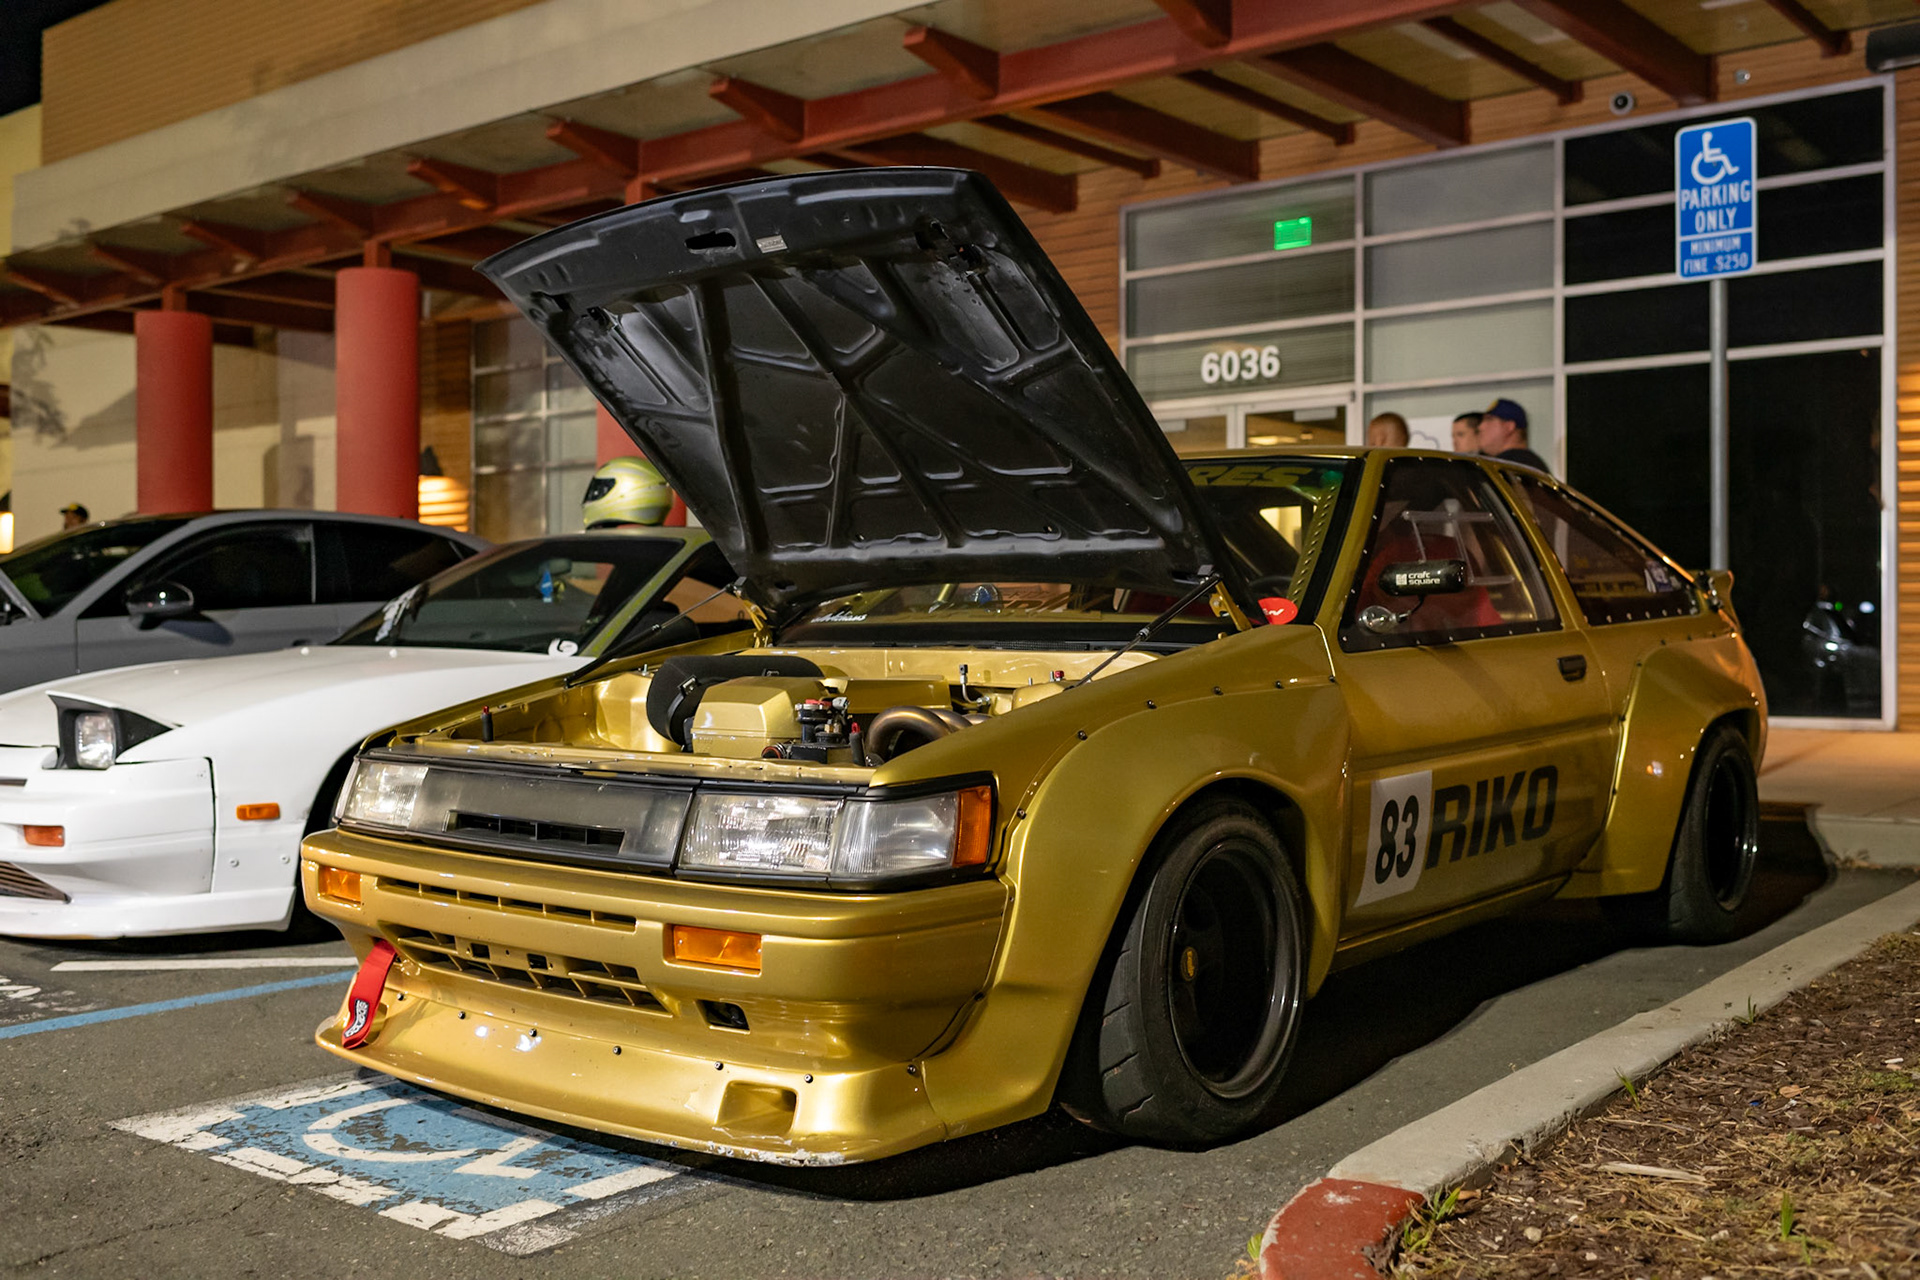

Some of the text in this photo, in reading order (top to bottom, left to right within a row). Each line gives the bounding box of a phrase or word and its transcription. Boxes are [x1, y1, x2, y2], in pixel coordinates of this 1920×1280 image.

[1680, 180, 1751, 211] PARKING
[1694, 207, 1737, 233] ONLY
[1690, 236, 1741, 256] MINIMUM
[1683, 252, 1749, 275] FINE $250
[1200, 345, 1280, 383] 6036
[1408, 571, 1431, 579] craft
[1408, 577, 1441, 586] square
[1374, 765, 1558, 885] 83 RIKO
